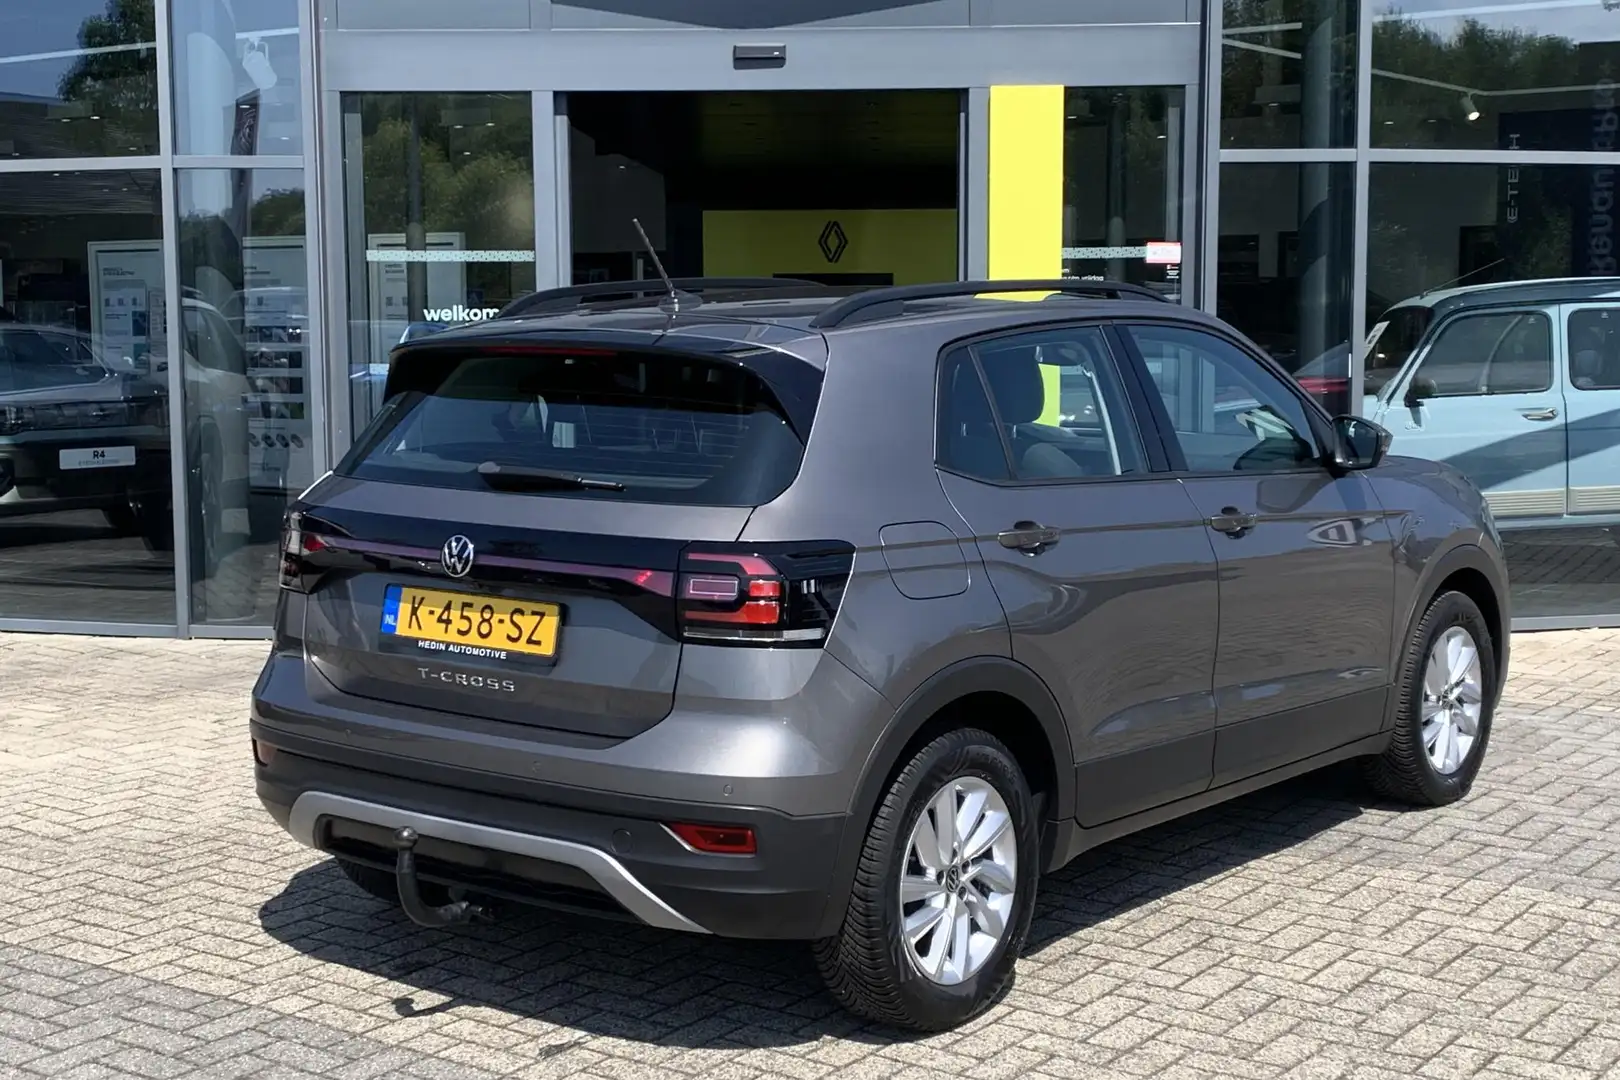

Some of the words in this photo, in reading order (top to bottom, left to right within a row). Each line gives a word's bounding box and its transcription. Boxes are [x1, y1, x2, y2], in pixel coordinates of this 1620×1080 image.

[1507, 133, 1520, 223] E-TEH
[423, 304, 500, 321] welkom
[93, 450, 106, 460] R4
[384, 614, 397, 626] NL
[408, 595, 546, 646] K-458-SZ
[418, 640, 446, 651] HEDIN
[448, 645, 507, 659] AUTOMOTIVE
[417, 667, 515, 692] T-CROSS
